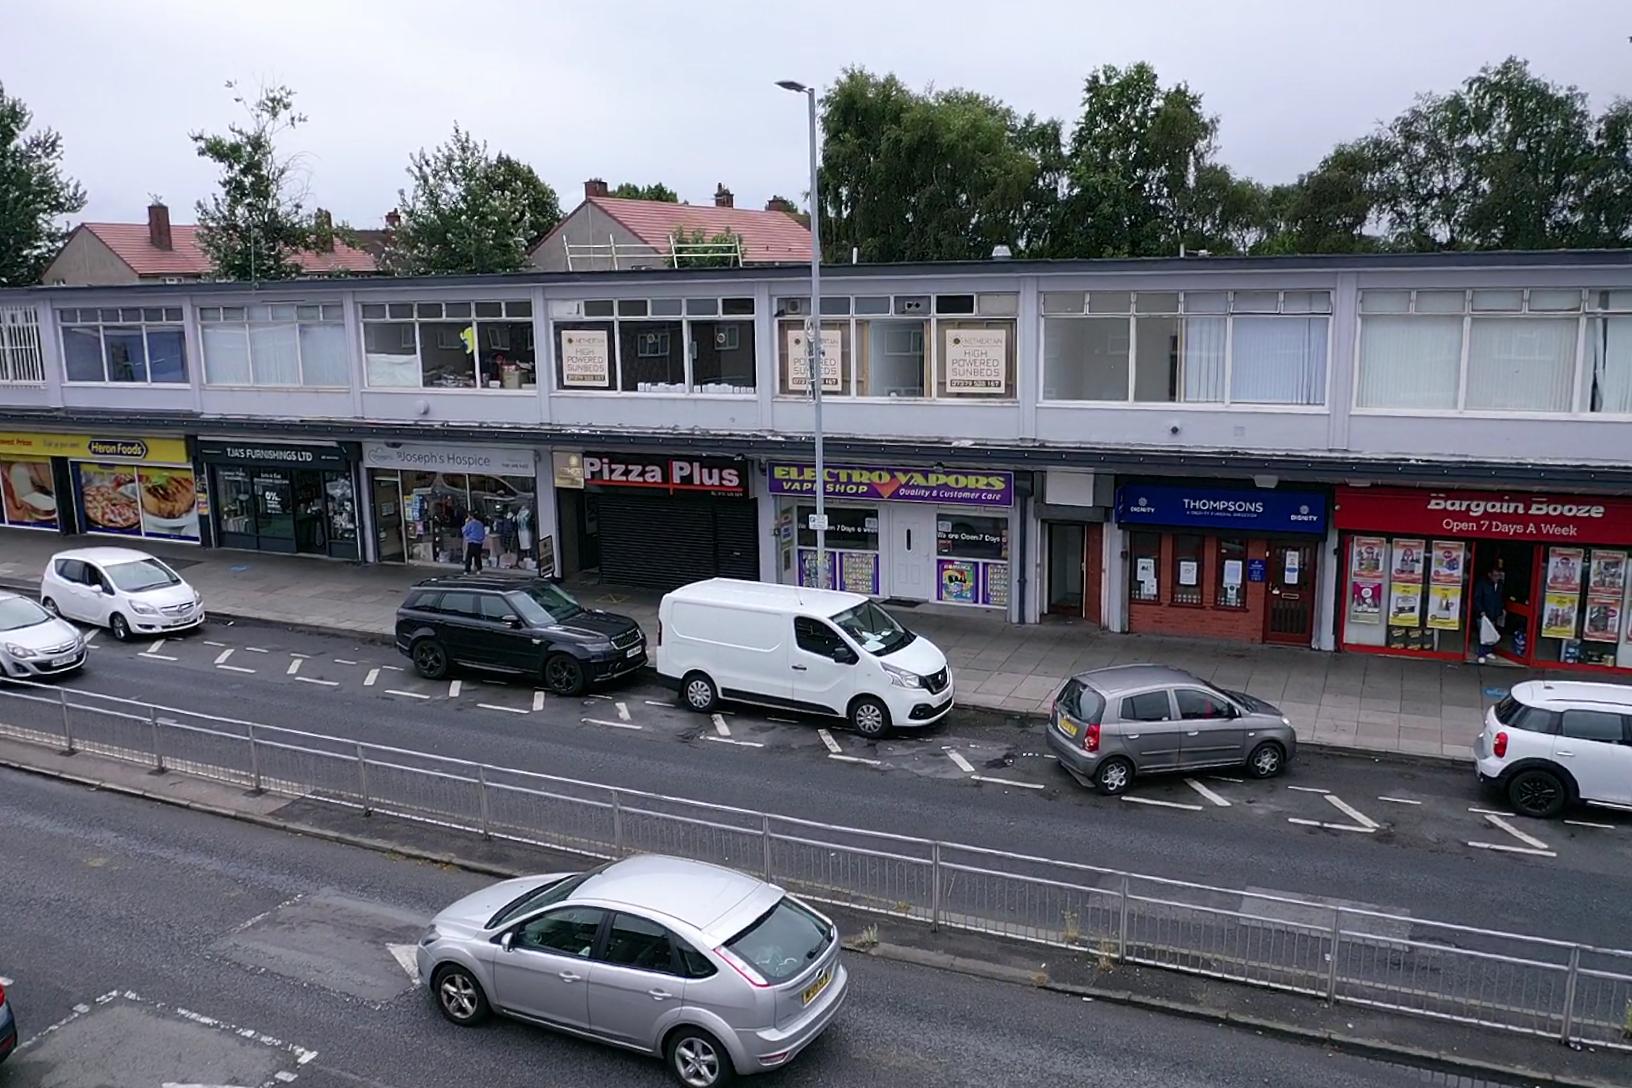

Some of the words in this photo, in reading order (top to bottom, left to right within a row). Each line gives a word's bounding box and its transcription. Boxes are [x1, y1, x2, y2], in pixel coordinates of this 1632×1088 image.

[567, 355, 604, 364] POWERED
[964, 349, 988, 358] HIGH
[567, 363, 605, 373] SUNBEDS
[951, 358, 1000, 368] POWERED
[951, 368, 1001, 377] SUNBEDS
[91, 442, 117, 454] Heron
[117, 443, 142, 455] Foods
[246, 449, 297, 461] FURNISHINGS
[297, 451, 313, 462] LTD
[402, 451, 445, 465] Joseph's
[447, 455, 491, 467] Hospice
[583, 457, 663, 483] Pizza
[671, 460, 740, 487] Plus
[773, 465, 890, 484] ELECTRO
[893, 470, 1006, 491] VAPORS
[825, 483, 868, 494] SHOP
[898, 487, 930, 498] Quality
[931, 489, 938, 497] &
[939, 489, 979, 499] Customer
[981, 492, 1003, 501] Care
[1182, 498, 1264, 513] THOMPSONS
[1427, 493, 1525, 517] Bargain
[1528, 497, 1605, 518] Booze
[1290, 514, 1319, 522] DIGNITY
[1442, 518, 1477, 533] Open
[1480, 519, 1489, 531] 7
[1491, 520, 1524, 536] Days
[1526, 523, 1537, 534] A
[1540, 523, 1578, 536] Week
[985, 534, 1000, 544] Days
